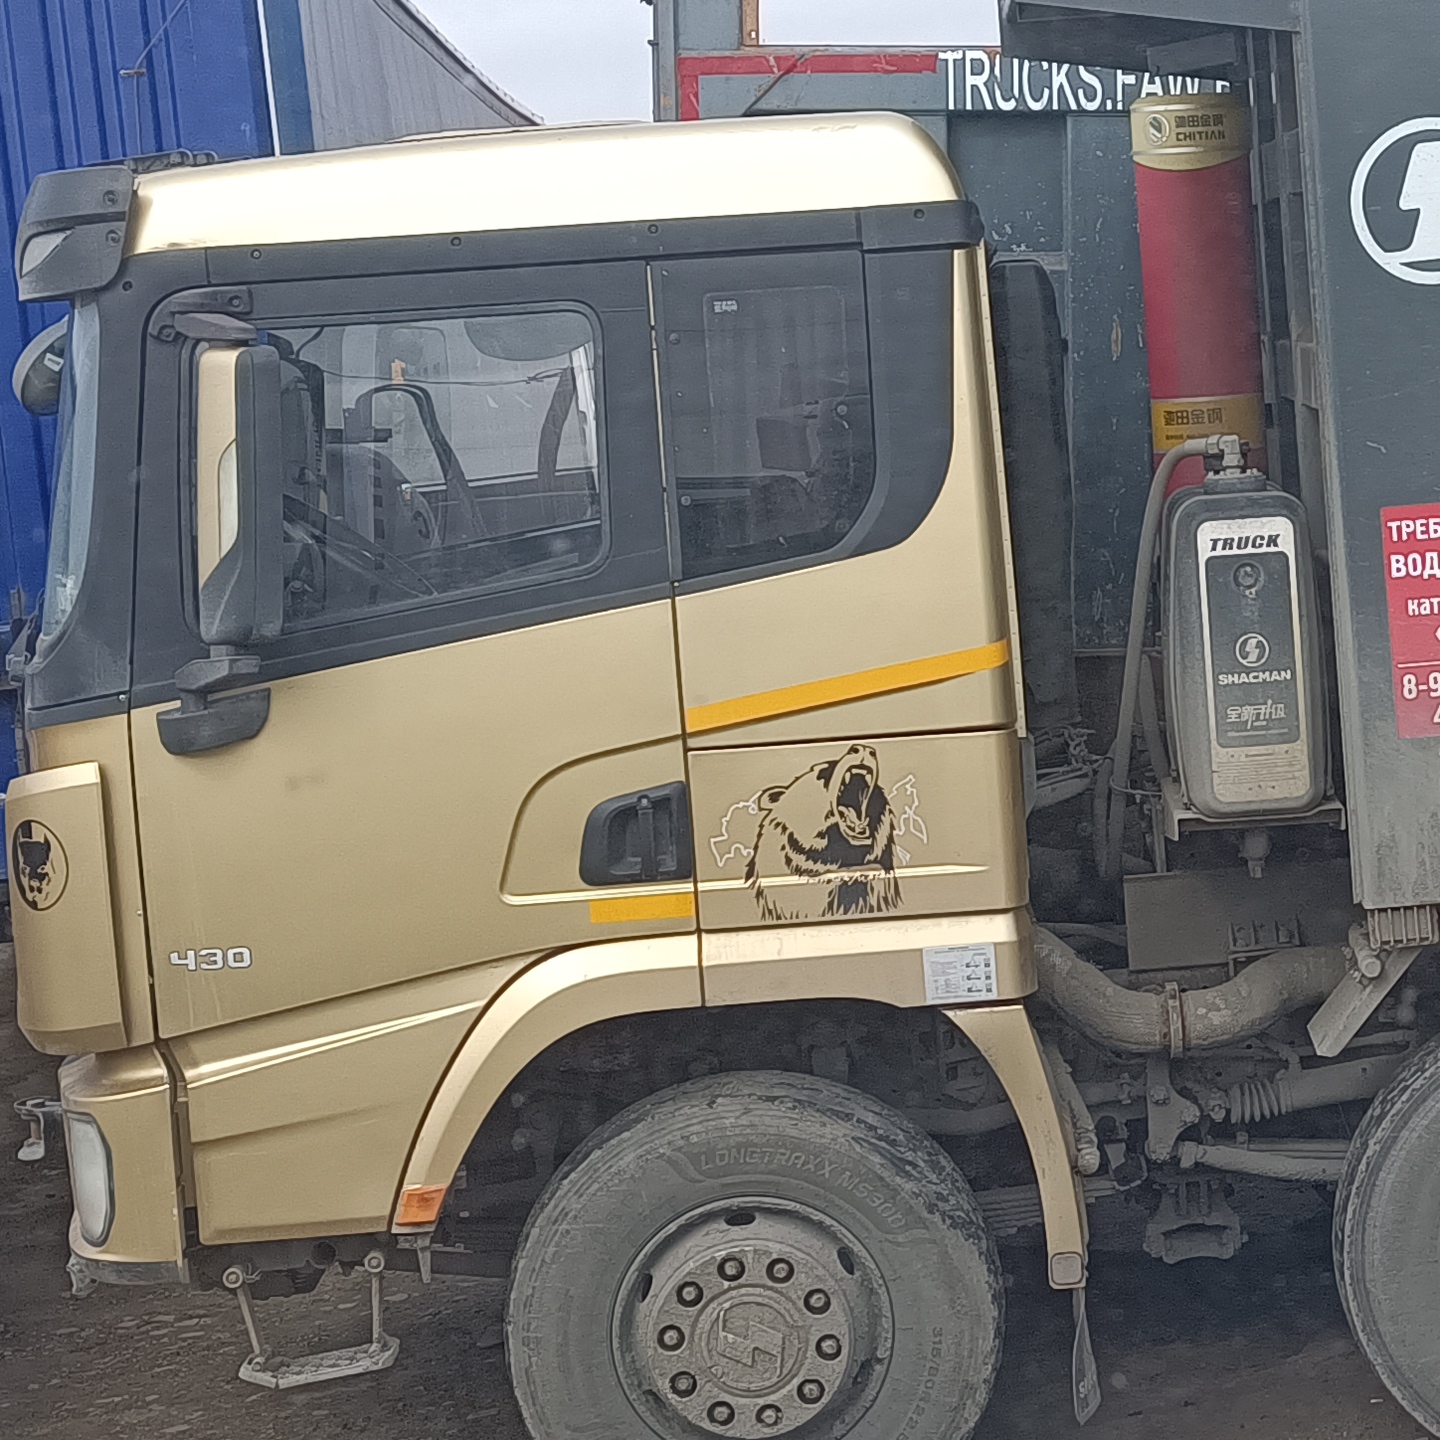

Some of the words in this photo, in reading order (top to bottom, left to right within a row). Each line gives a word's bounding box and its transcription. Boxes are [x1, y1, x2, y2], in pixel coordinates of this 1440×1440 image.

[1175, 129, 1226, 142] CHITIAN
[1209, 533, 1281, 553] TRUCK
[1217, 669, 1292, 685] SHACMAN
[169, 946, 252, 971] 430
